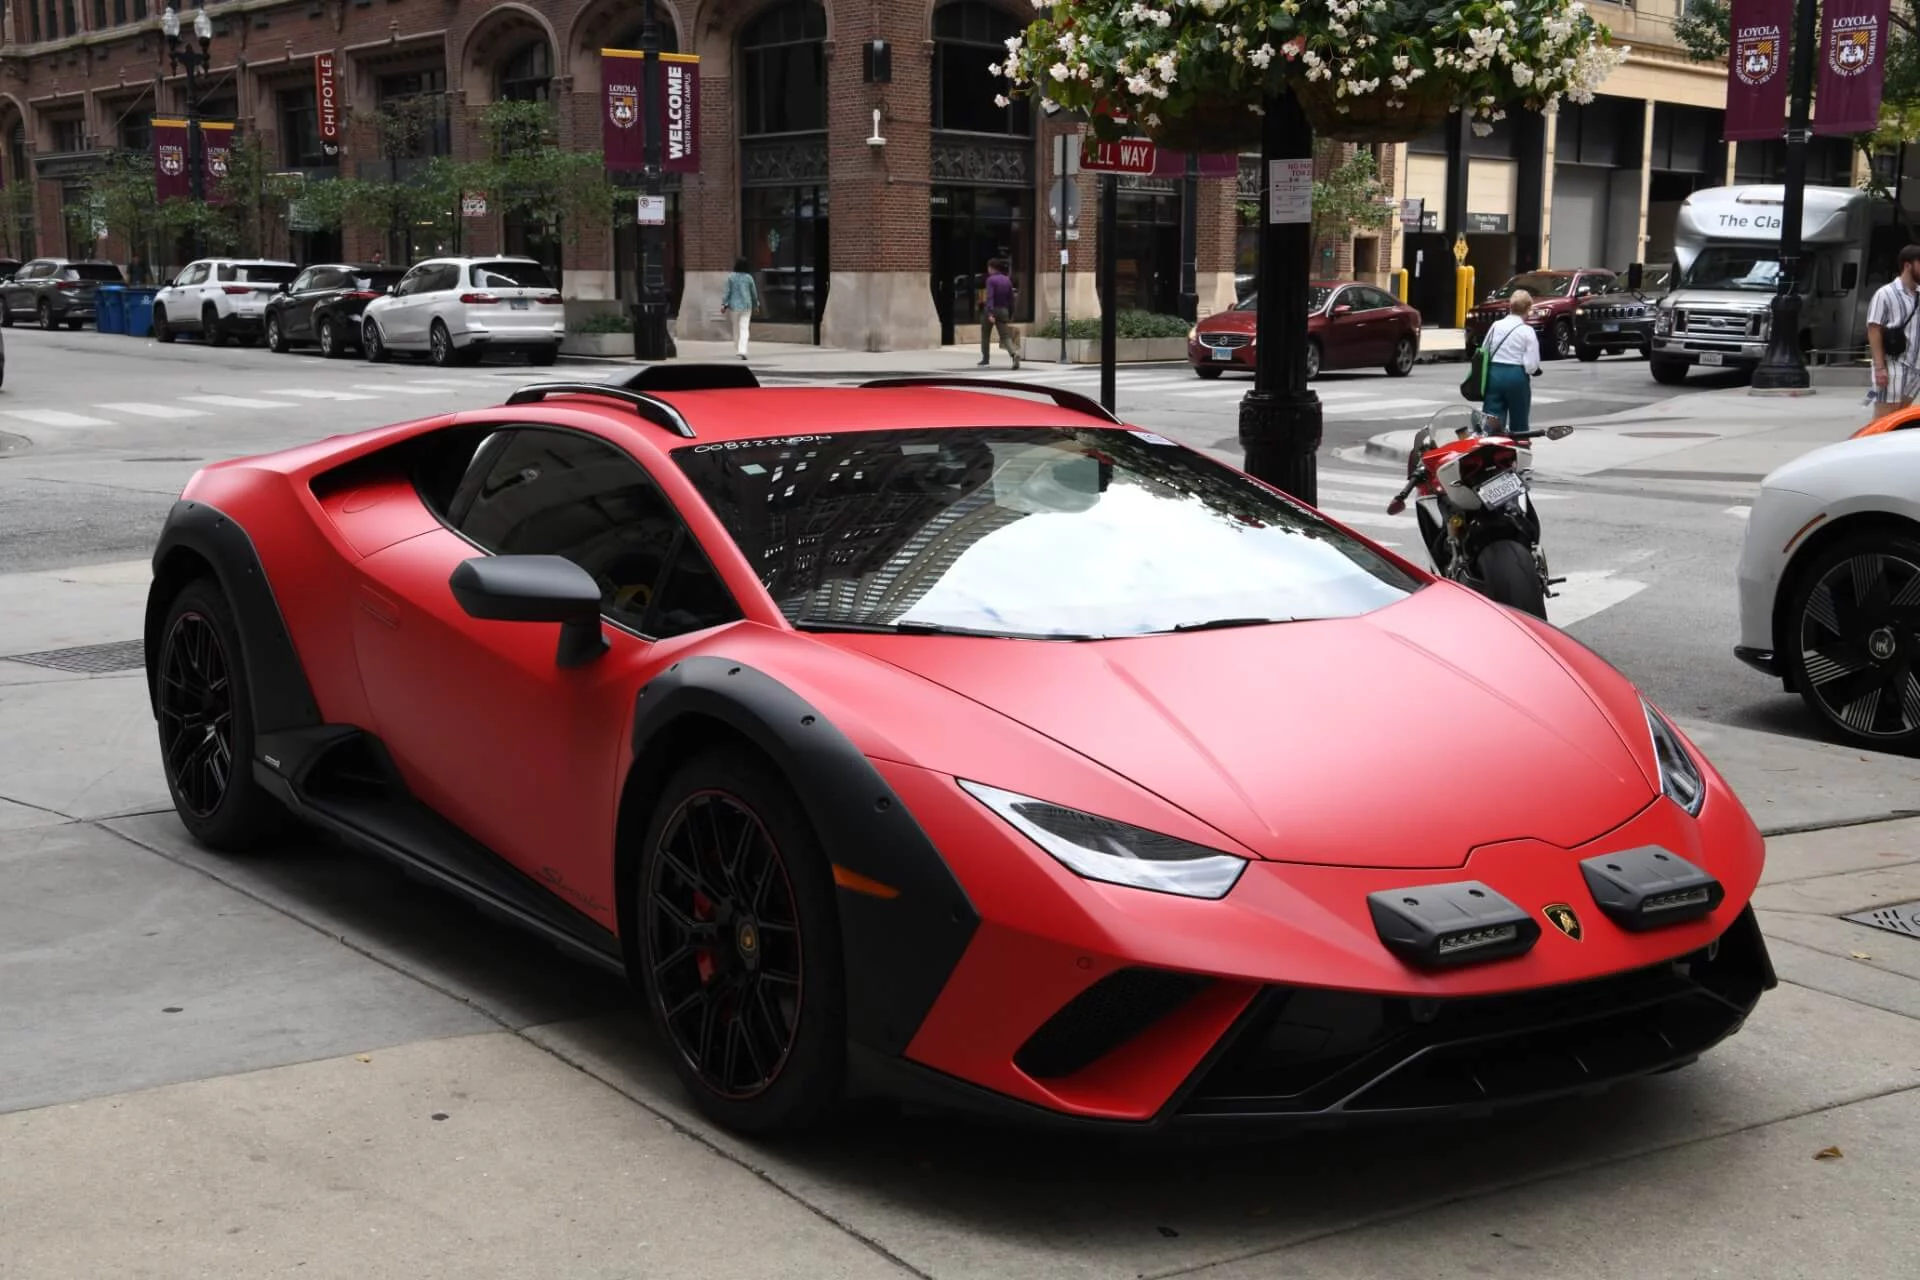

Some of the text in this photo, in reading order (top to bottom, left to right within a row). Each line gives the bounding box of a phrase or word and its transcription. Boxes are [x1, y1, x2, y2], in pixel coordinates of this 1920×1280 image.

[1832, 15, 1878, 28] LOYOLA
[1738, 25, 1780, 38] LOYOLA
[609, 84, 637, 93] LOYOLA
[320, 58, 336, 136] CHIPOTLE
[668, 66, 683, 159] WELCOME
[1120, 144, 1149, 168] WAY
[1720, 214, 1748, 227] The
